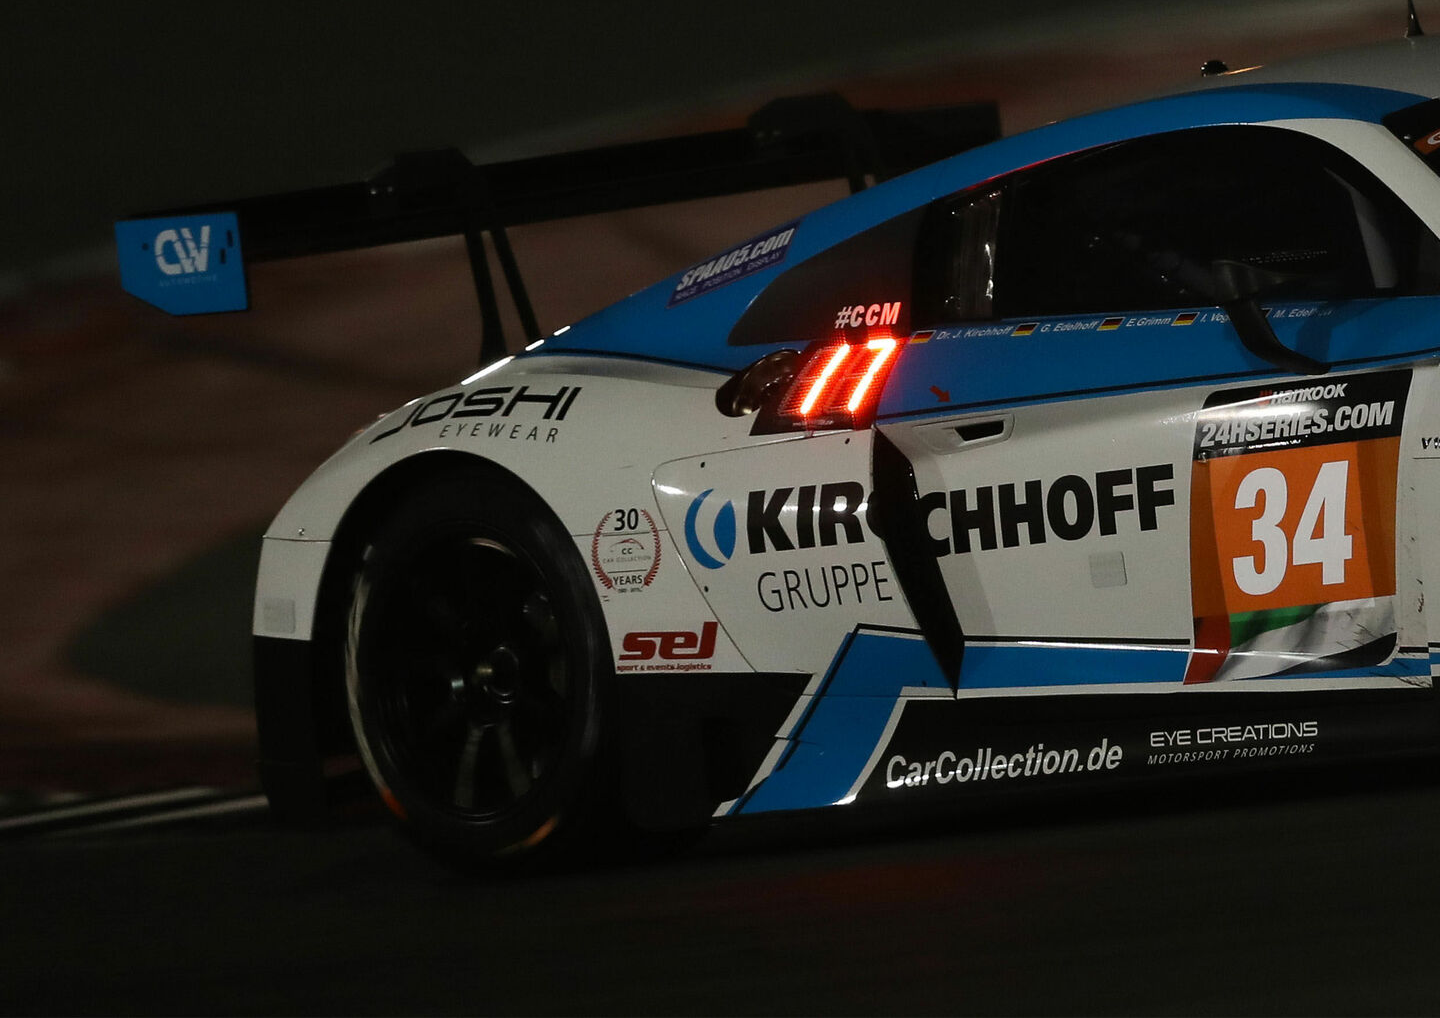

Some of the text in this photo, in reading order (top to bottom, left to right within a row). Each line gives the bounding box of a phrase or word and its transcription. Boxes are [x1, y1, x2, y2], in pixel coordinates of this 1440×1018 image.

[834, 301, 902, 329] #CCM
[371, 386, 582, 444] JOSHI
[1200, 400, 1395, 448] 24HSERIES.COM
[439, 423, 558, 443] EYEWEAR
[614, 507, 640, 531] 30
[1232, 459, 1353, 597] 34
[612, 574, 643, 585] YEARS
[757, 560, 893, 612] GRUPPE
[619, 621, 718, 660] sel
[1149, 721, 1319, 748] EYE CREATIONS
[886, 737, 1124, 790] CarCollection.de
[1147, 742, 1316, 765] MOTORSPORT PROMOTIONS
